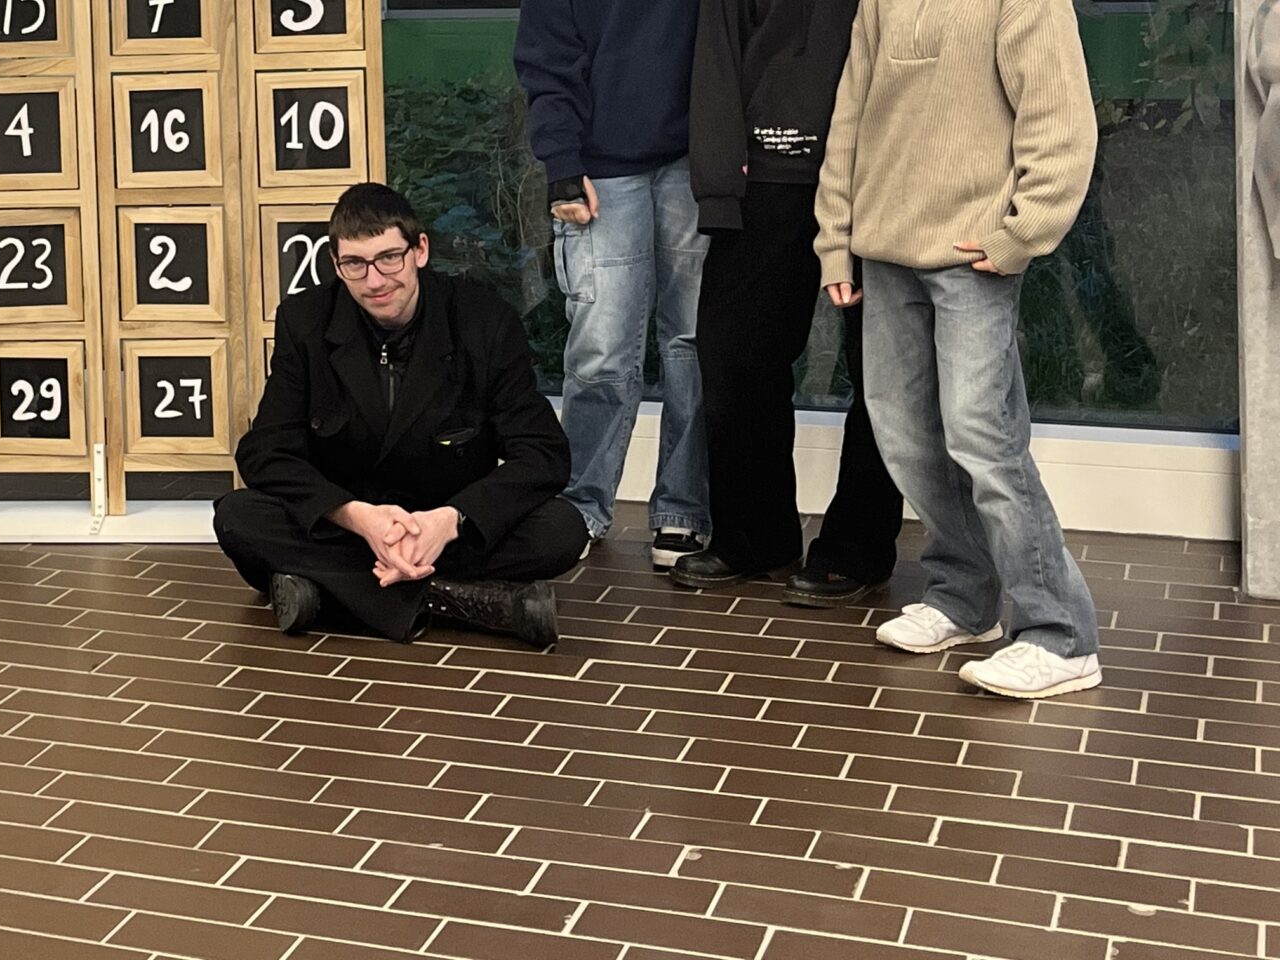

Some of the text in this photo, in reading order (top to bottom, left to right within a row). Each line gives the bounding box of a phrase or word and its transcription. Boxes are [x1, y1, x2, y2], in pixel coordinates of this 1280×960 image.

[4, 103, 34, 157] 4
[140, 108, 190, 153] 16
[279, 100, 345, 150] 10
[148, 235, 193, 292] 2
[10, 377, 62, 421] 29
[154, 378, 208, 420] 27
